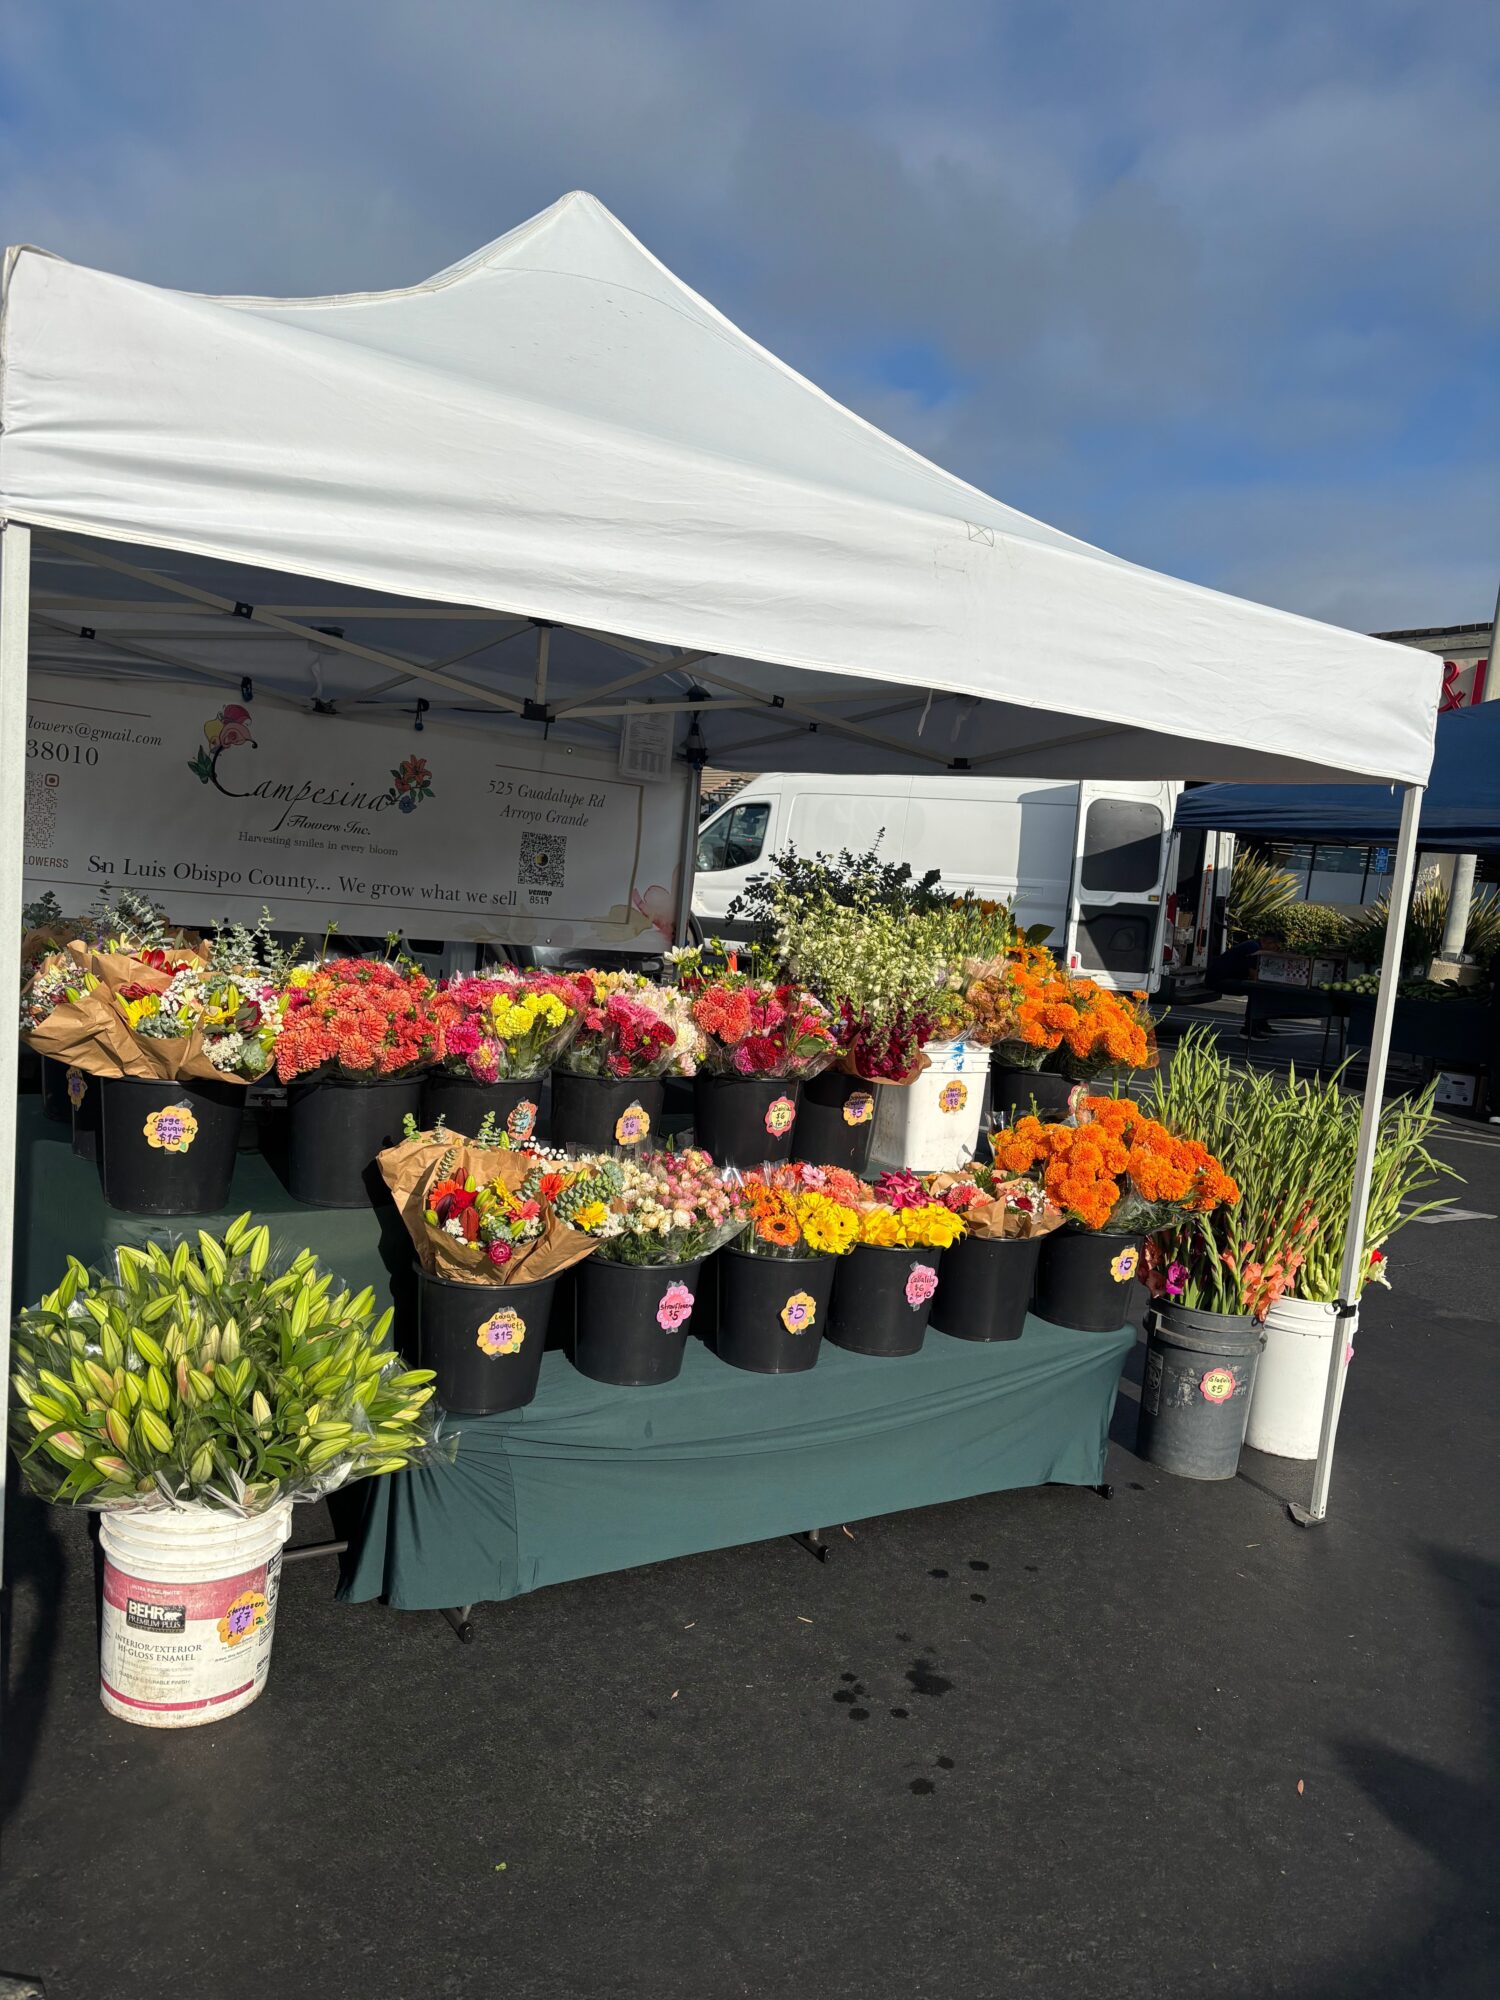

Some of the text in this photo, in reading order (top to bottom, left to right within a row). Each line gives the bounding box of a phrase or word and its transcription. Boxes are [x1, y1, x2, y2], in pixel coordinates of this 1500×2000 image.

[210, 738, 395, 832] Campesina
[486, 780, 606, 808] 525 Guadalupe Rd
[500, 804, 589, 827] Arroyo Grande
[286, 815, 371, 835] Flowers Inc.
[238, 832, 398, 856] Harvesting smiles in every bloom
[123, 858, 166, 878] Luis
[174, 862, 242, 888] Obispo
[248, 868, 330, 894] County...
[338, 876, 366, 894] We
[370, 882, 414, 900] grow
[420, 884, 460, 901] what
[466, 892, 488, 904] we
[492, 890, 517, 906] sell
[530, 896, 549, 904] 8519
[152, 1115, 180, 1125] Large
[156, 1123, 194, 1135] Bouquets
[157, 1132, 181, 1145] $15
[1120, 1257, 1134, 1270] $5
[669, 1310, 680, 1320] $5
[788, 1304, 806, 1319] $5
[489, 1321, 522, 1331] Bouquets
[494, 1331, 512, 1341] $15
[1211, 1384, 1223, 1393] $5
[128, 1600, 164, 1620] BEHR
[128, 1615, 181, 1628] PREMIUM PLUS
[115, 1632, 202, 1653] INTERIOR/EXTERIOR
[118, 1644, 196, 1662] HI-GLOSS ENAMEL
